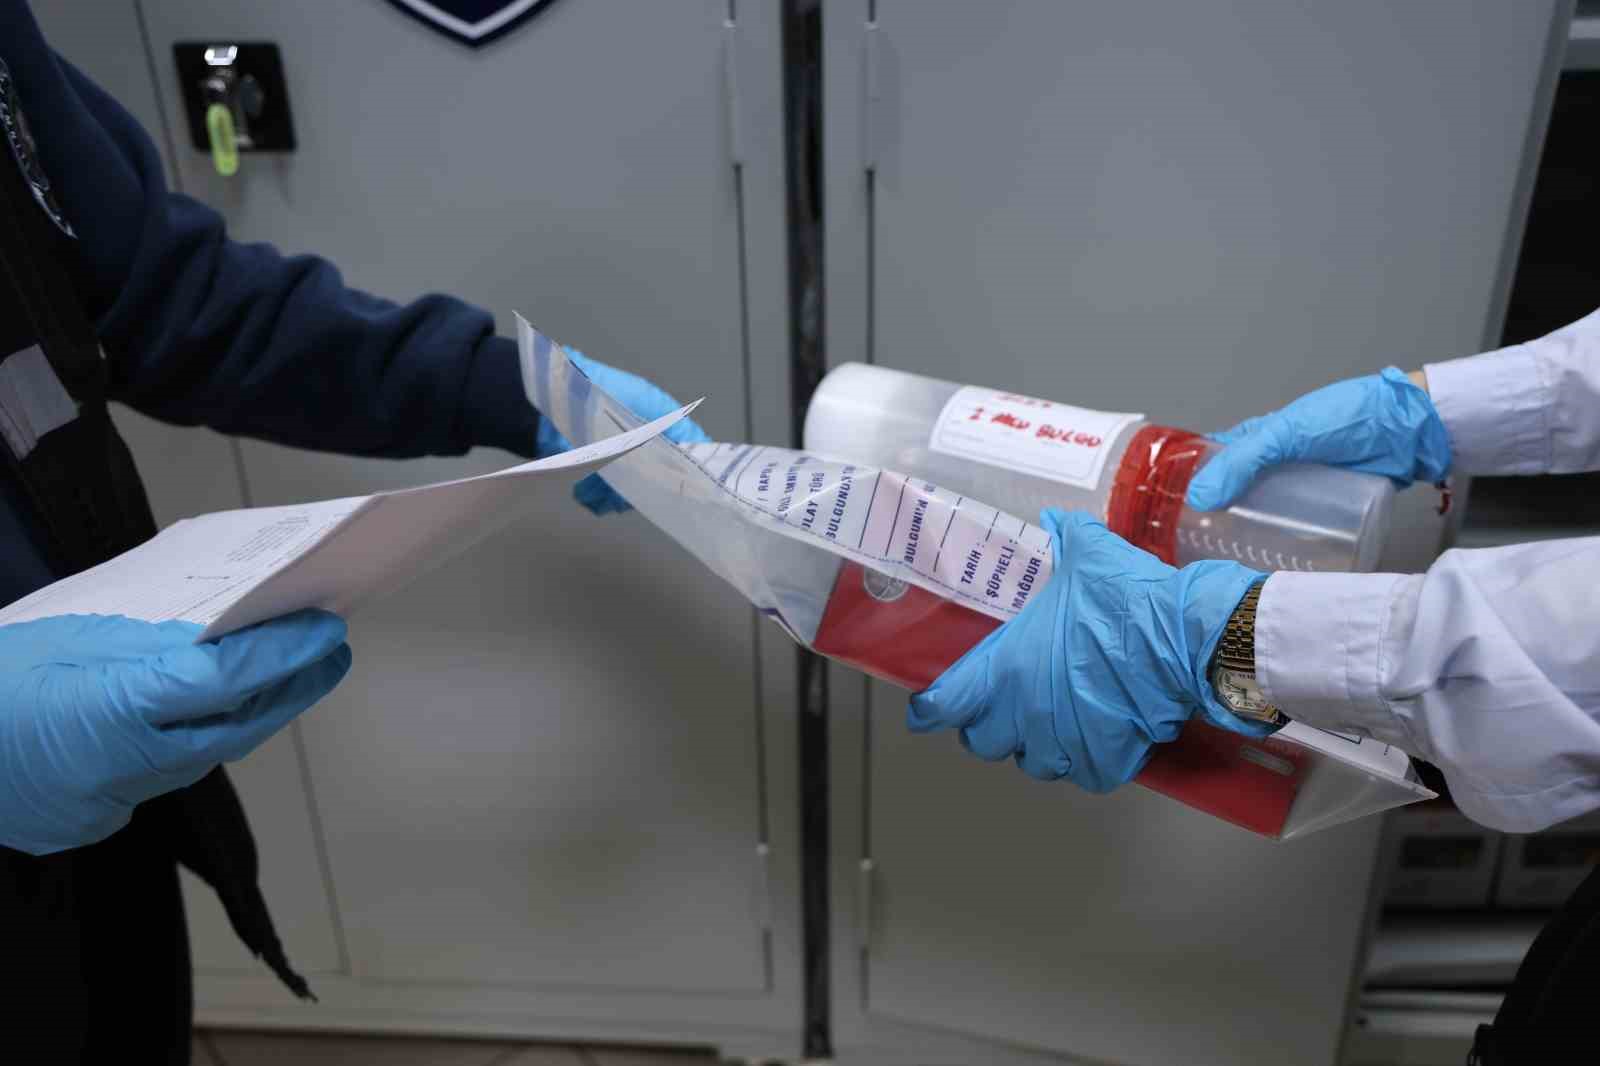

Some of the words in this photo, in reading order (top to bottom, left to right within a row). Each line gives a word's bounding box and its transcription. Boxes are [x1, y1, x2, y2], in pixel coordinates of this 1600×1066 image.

[960, 549, 983, 585] TARİH
[986, 545, 1015, 598] ŞÜPHELİ
[1011, 557, 1042, 610] MAĞDUR
